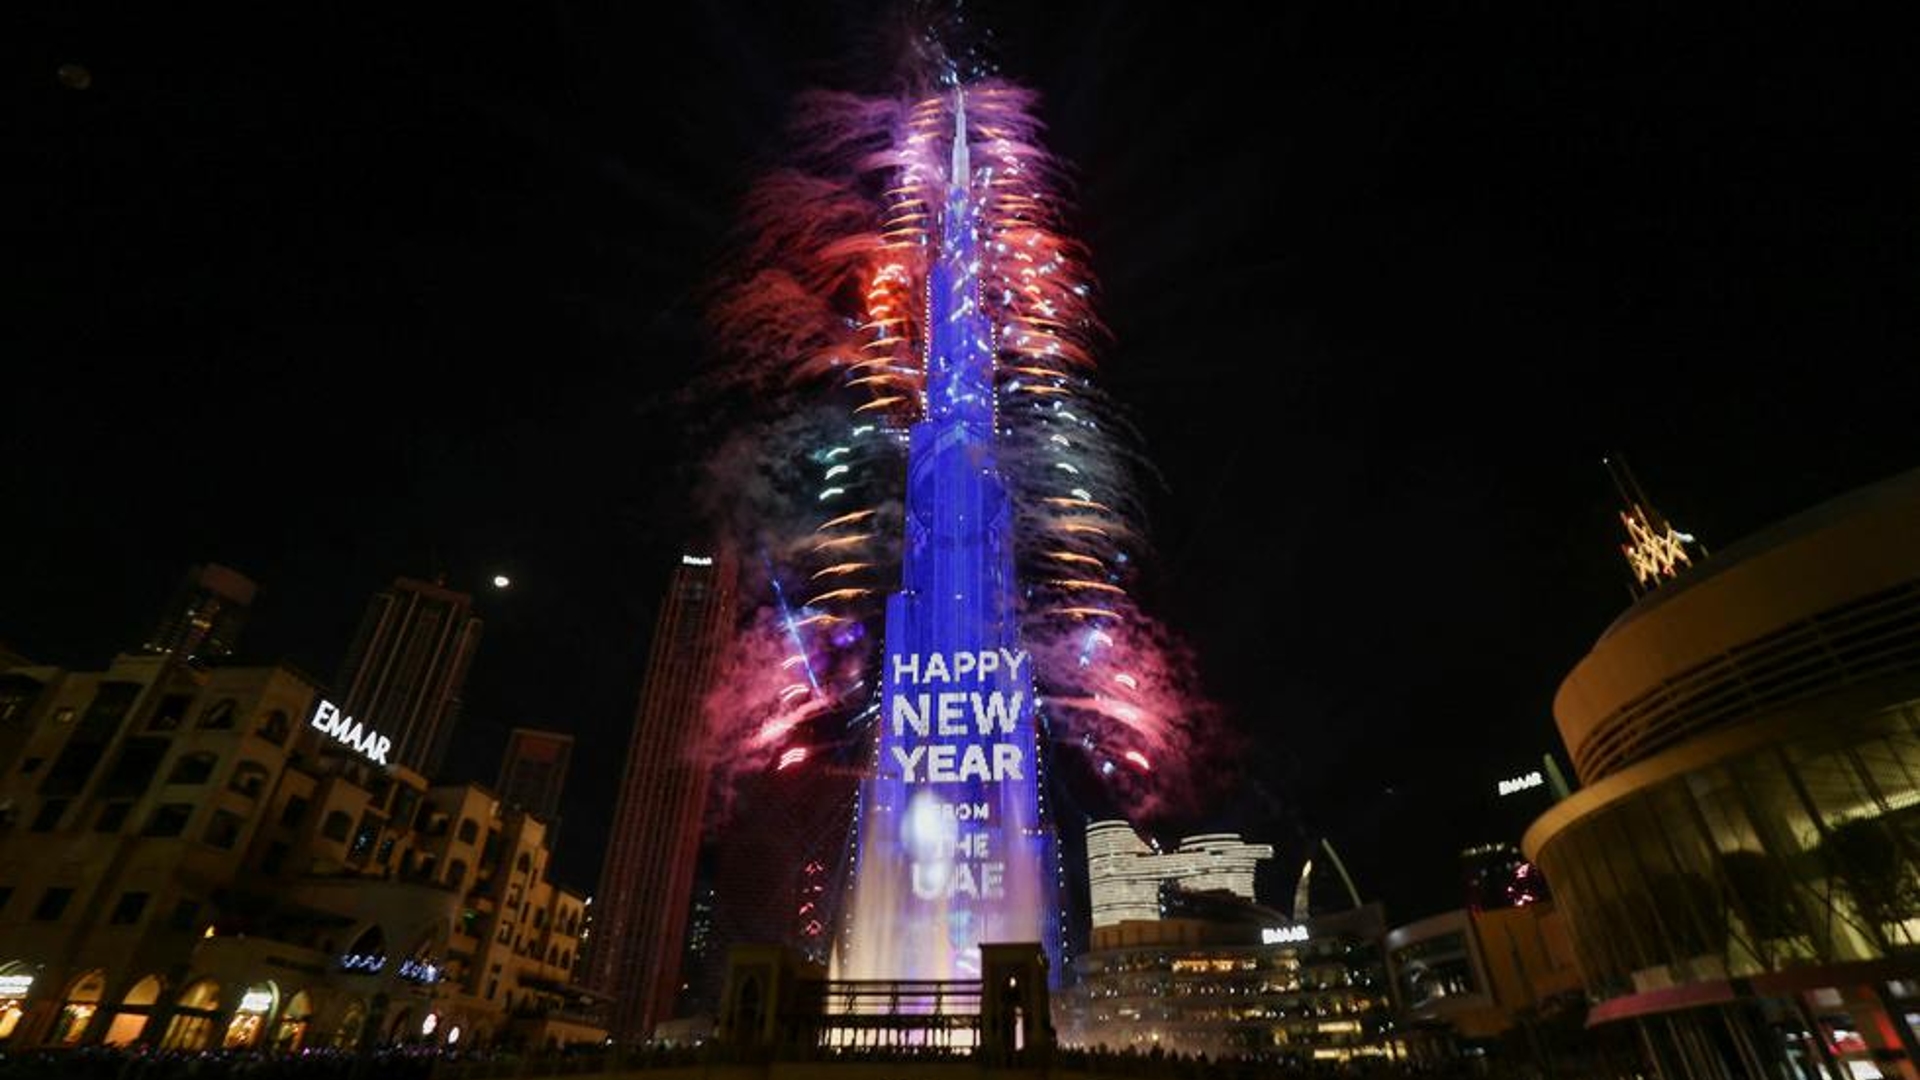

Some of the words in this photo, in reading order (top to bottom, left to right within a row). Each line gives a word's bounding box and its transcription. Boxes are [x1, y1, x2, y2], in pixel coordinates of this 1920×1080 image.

[893, 648, 1027, 684] HAPPY
[311, 699, 391, 765] EMAAR
[893, 690, 1024, 736] NEW
[891, 743, 1024, 782] YEAR
[912, 863, 1004, 900] UAE
